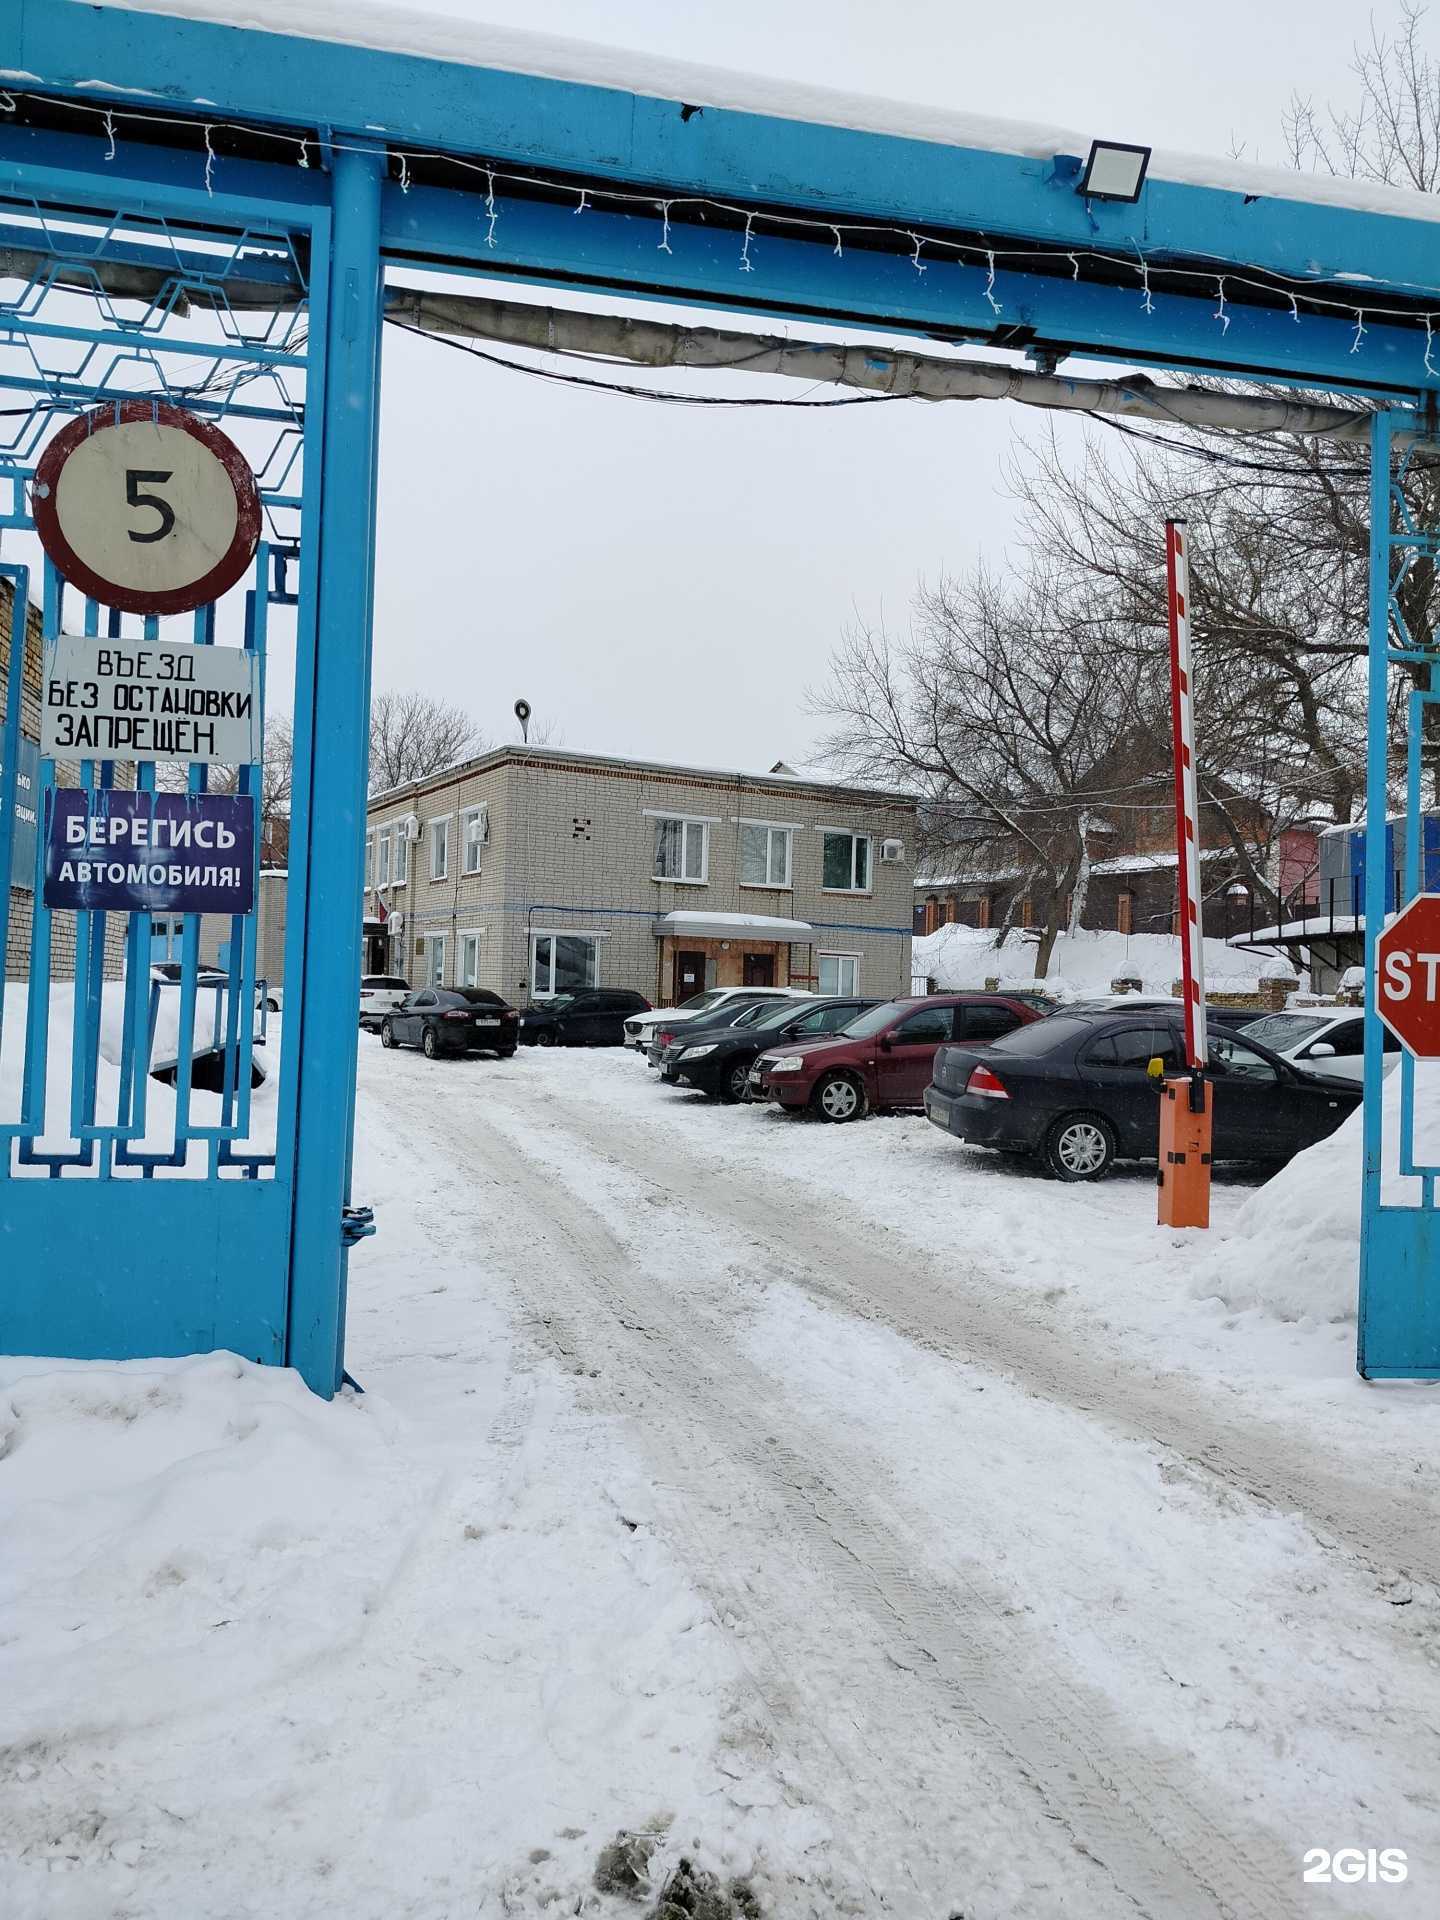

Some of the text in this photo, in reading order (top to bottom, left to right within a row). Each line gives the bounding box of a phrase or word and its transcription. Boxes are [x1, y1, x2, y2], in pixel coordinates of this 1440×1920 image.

[126, 469, 176, 544] 5
[97, 649, 196, 682] ВЪЕЗД
[48, 680, 251, 720] БЕЗ ОСТАНОВКИ
[66, 815, 236, 849] БЕРЕГИСЬ
[58, 861, 241, 888] АВТОМОБИЛЯ!
